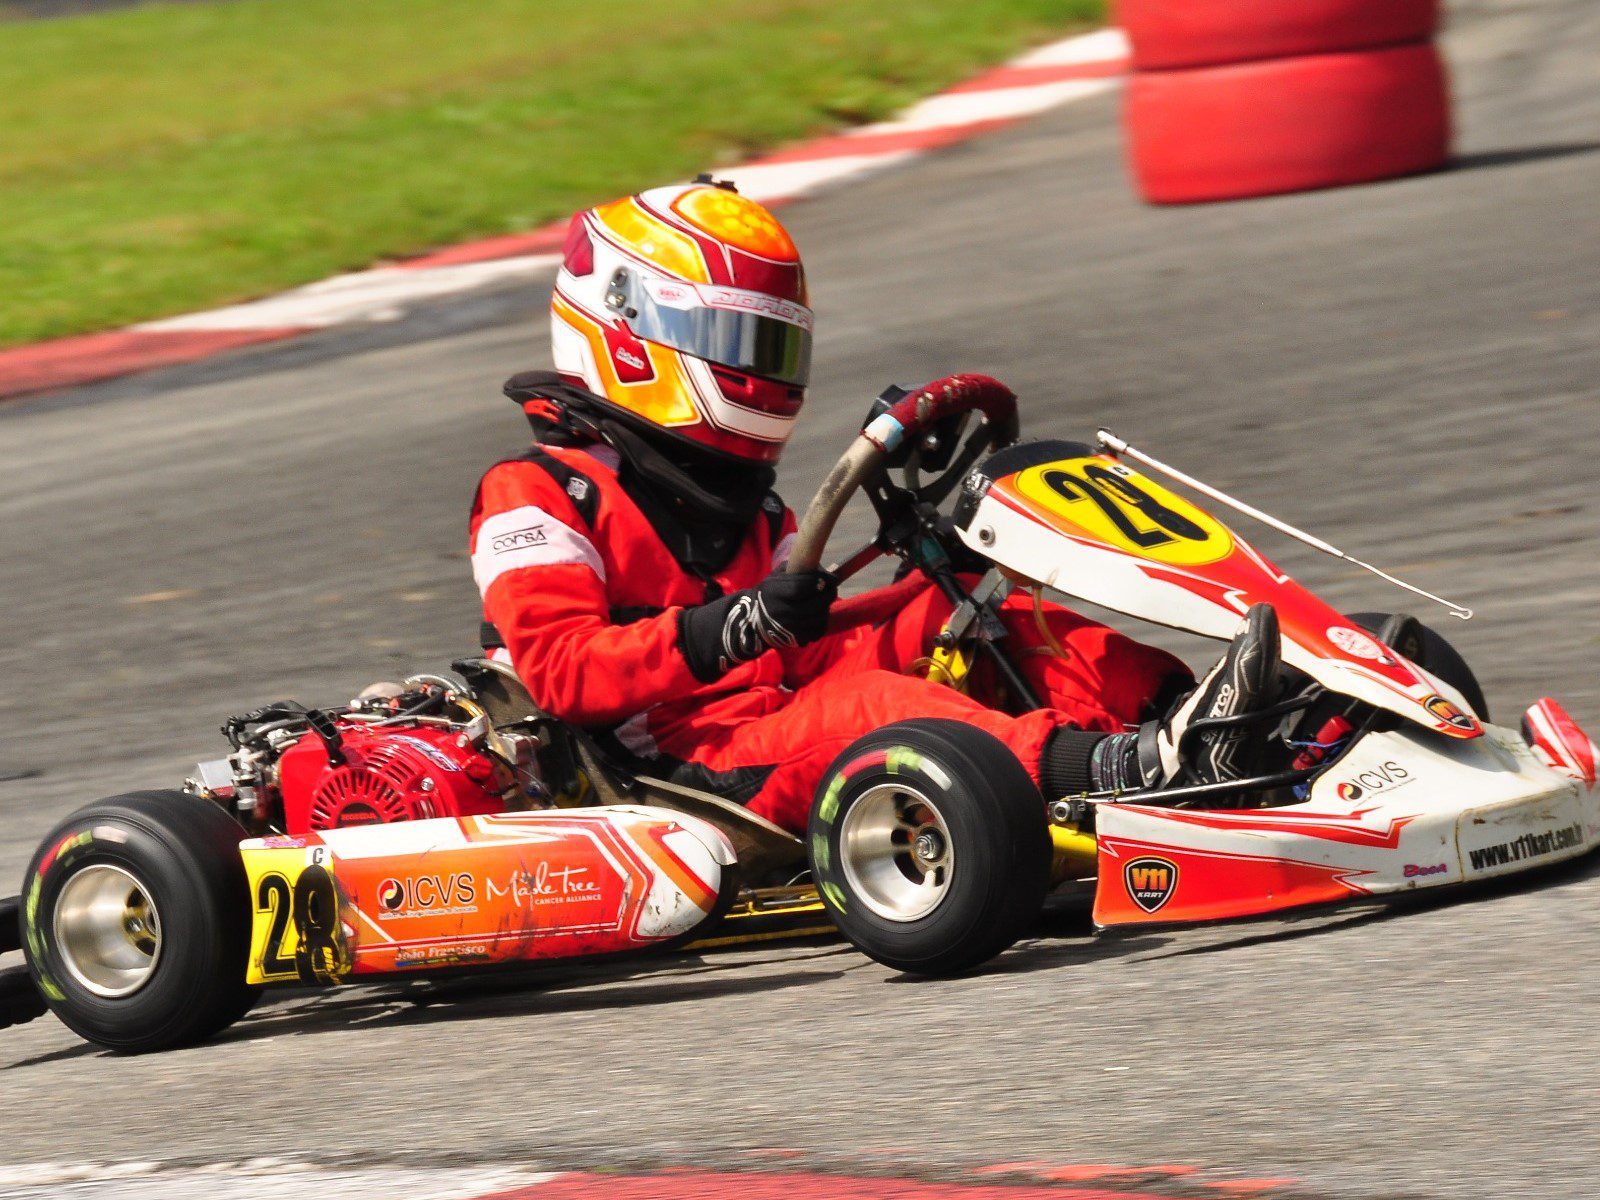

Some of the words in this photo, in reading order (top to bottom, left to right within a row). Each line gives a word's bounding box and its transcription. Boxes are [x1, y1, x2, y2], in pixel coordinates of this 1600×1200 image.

[1351, 761, 1408, 791] ICVS
[312, 847, 324, 864] C
[407, 873, 475, 908] ICVS
[549, 866, 600, 894] Tree
[534, 896, 564, 906] CANCER
[566, 893, 602, 903] ALLIANCE
